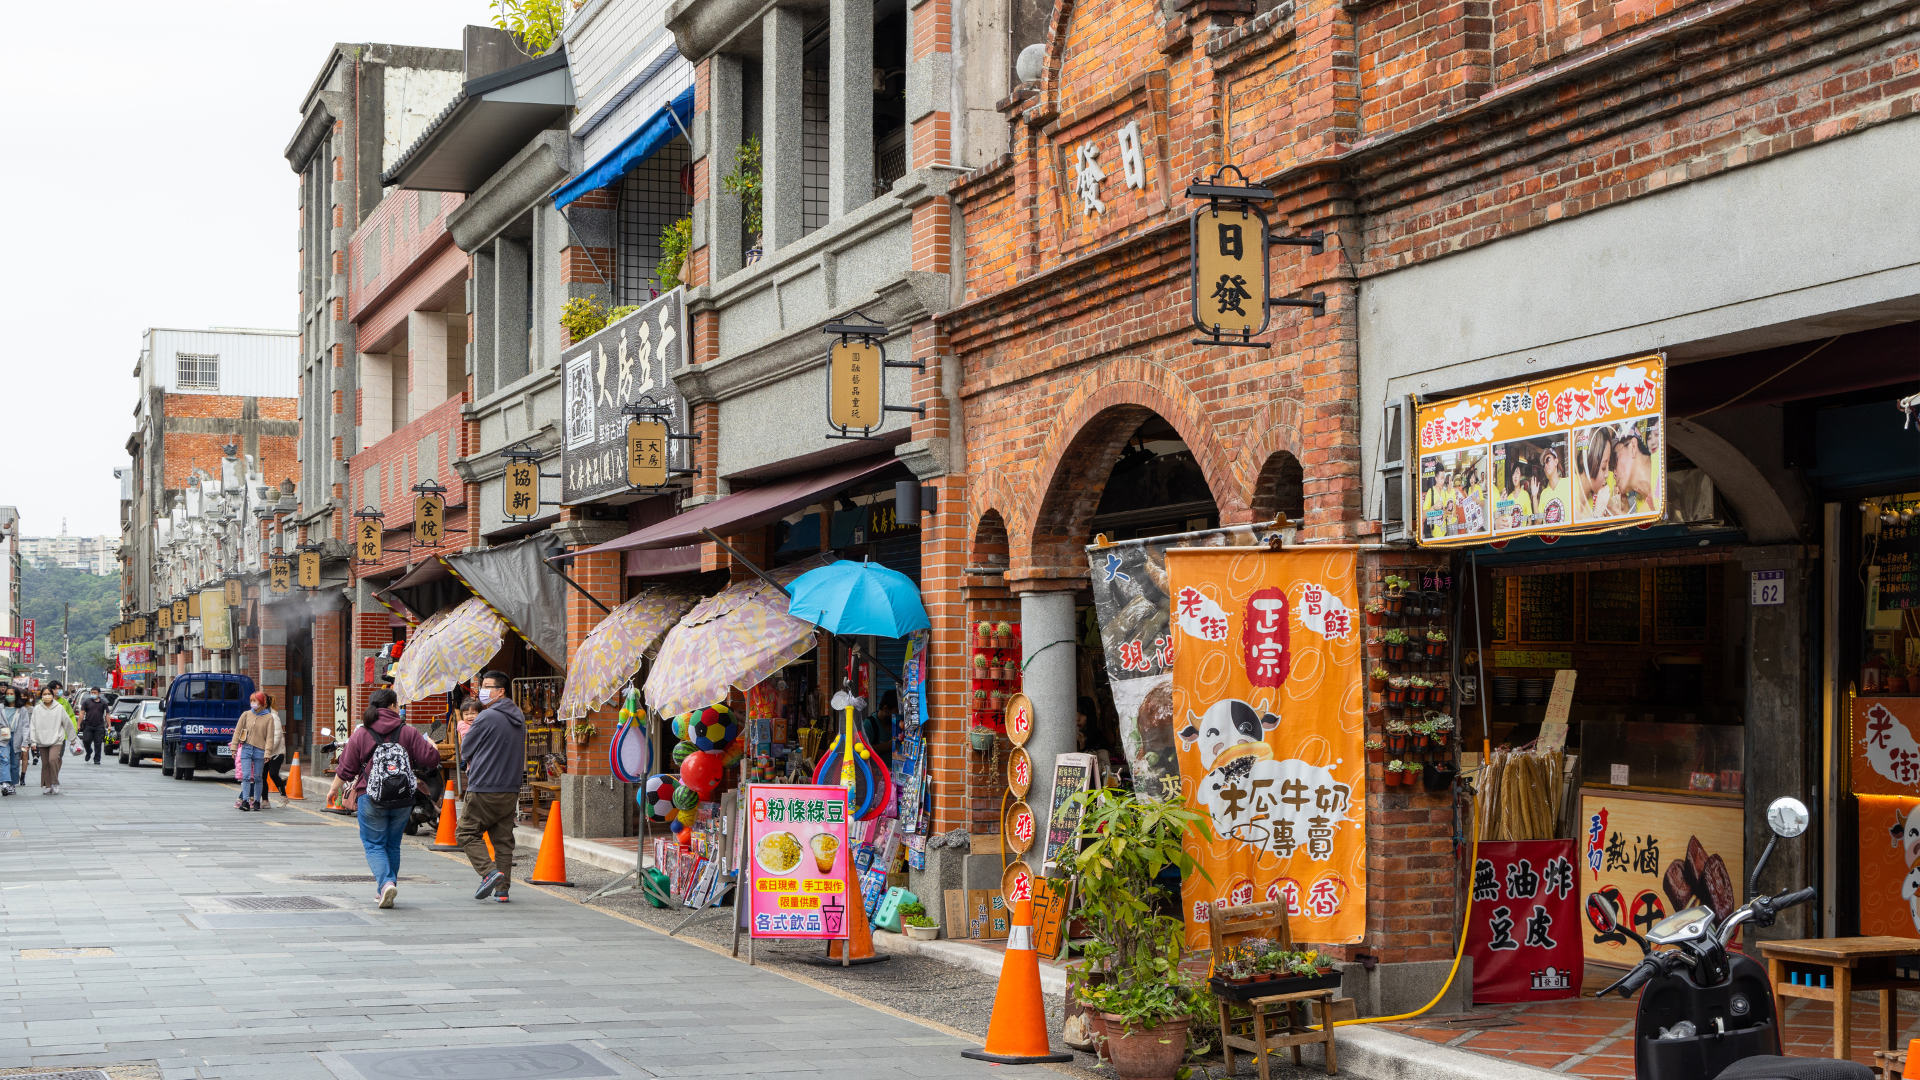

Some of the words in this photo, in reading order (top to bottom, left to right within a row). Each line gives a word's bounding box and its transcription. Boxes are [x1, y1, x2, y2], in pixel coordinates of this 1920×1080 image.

[1210, 223, 1252, 317] 日發
[512, 467, 531, 510] 協新
[361, 524, 377, 556] 全悅
[420, 500, 438, 537] 全悅
[273, 565, 288, 589] 協大
[1762, 584, 1778, 602] 62
[1179, 587, 1228, 640] 老街
[1304, 584, 1350, 638] 曾鮮
[1252, 598, 1283, 678] 正宗
[185, 724, 204, 735] BGR
[204, 727, 219, 735] KIA
[220, 727, 236, 735] MO
[1868, 706, 1919, 782] 老街
[767, 798, 846, 824] 粉條綠豆
[1219, 778, 1350, 821] 木瓜牛奶
[1272, 815, 1333, 860] 專賣
[1588, 815, 1603, 871] 手切
[1605, 831, 1659, 878] 熱滷
[804, 880, 843, 892] 手工製作
[1472, 857, 1573, 900] 無油炸
[756, 913, 821, 932] 各式飲品
[780, 896, 819, 908] 限量供應
[992, 895, 1006, 932] 珍珠
[1488, 905, 1557, 950] 豆皮
